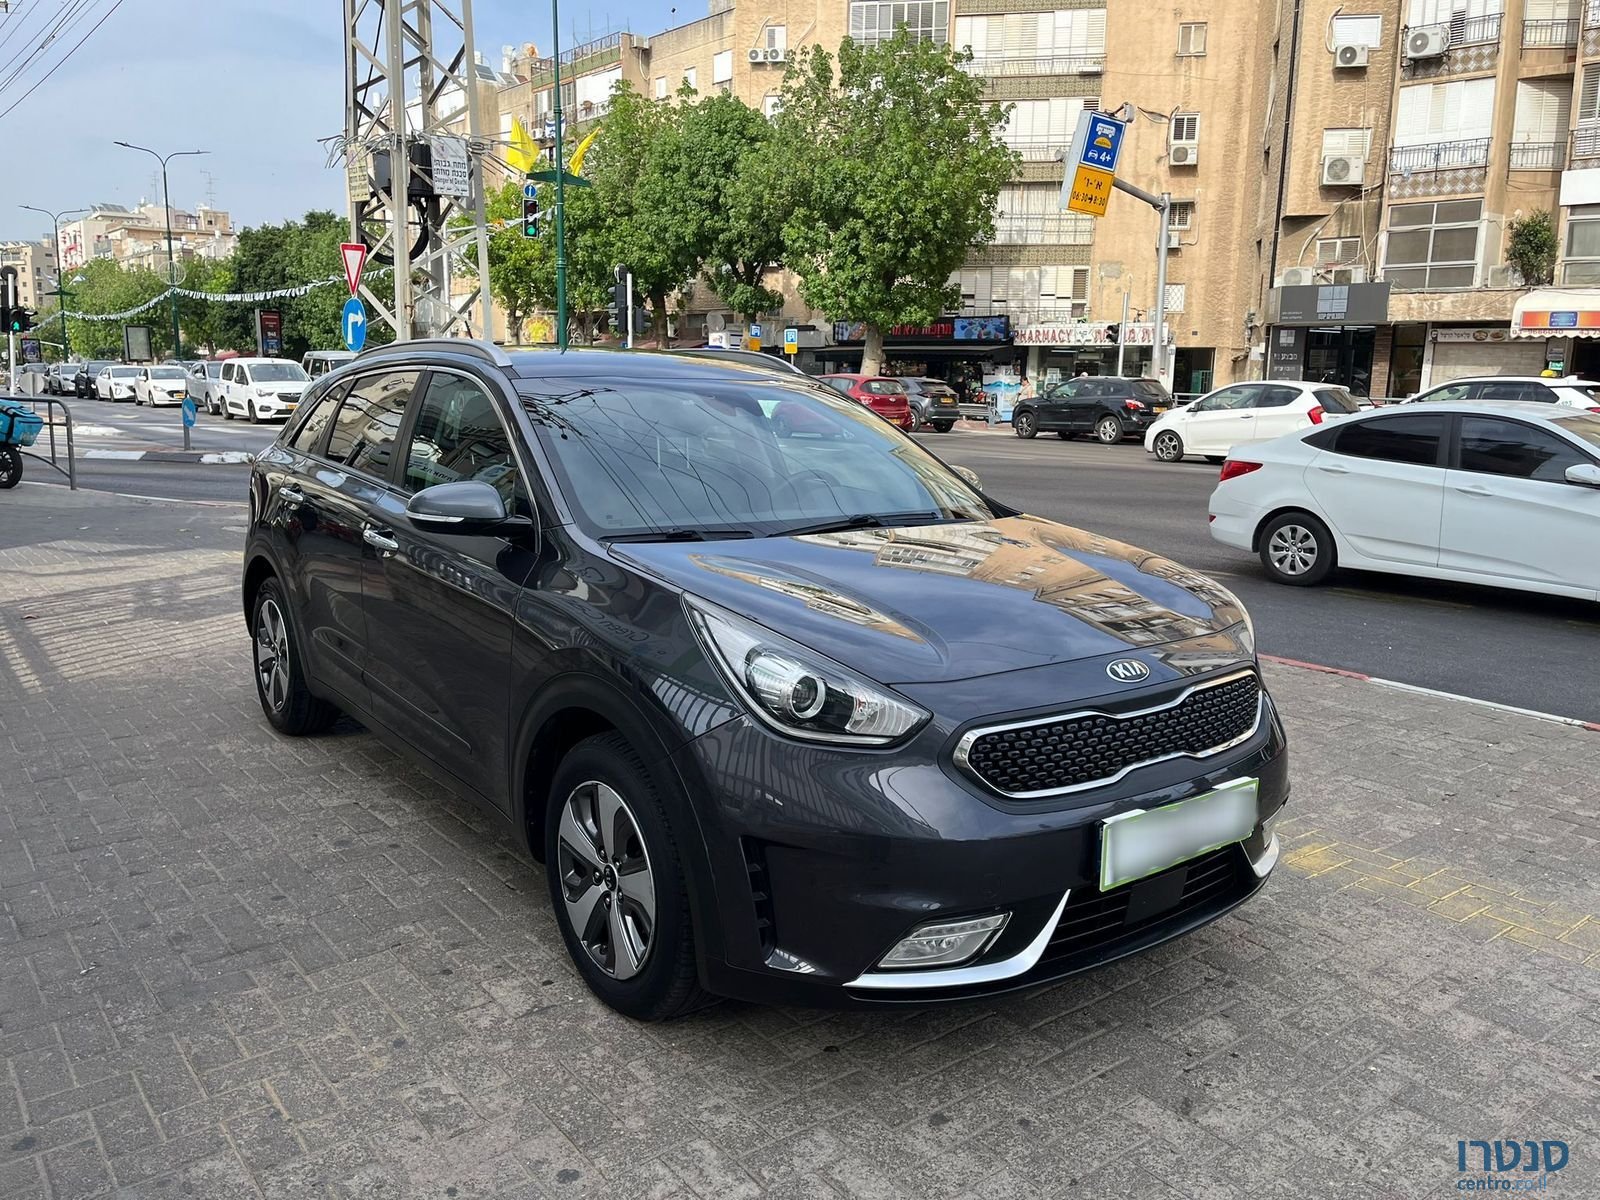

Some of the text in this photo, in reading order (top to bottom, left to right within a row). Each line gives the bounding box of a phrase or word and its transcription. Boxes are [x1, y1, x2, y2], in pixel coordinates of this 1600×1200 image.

[1100, 152, 1111, 162] 4+
[452, 161, 466, 169] מתח
[452, 170, 467, 178] סכנת
[1014, 329, 1072, 343] PHARMACY
[1112, 662, 1147, 678] KIA
